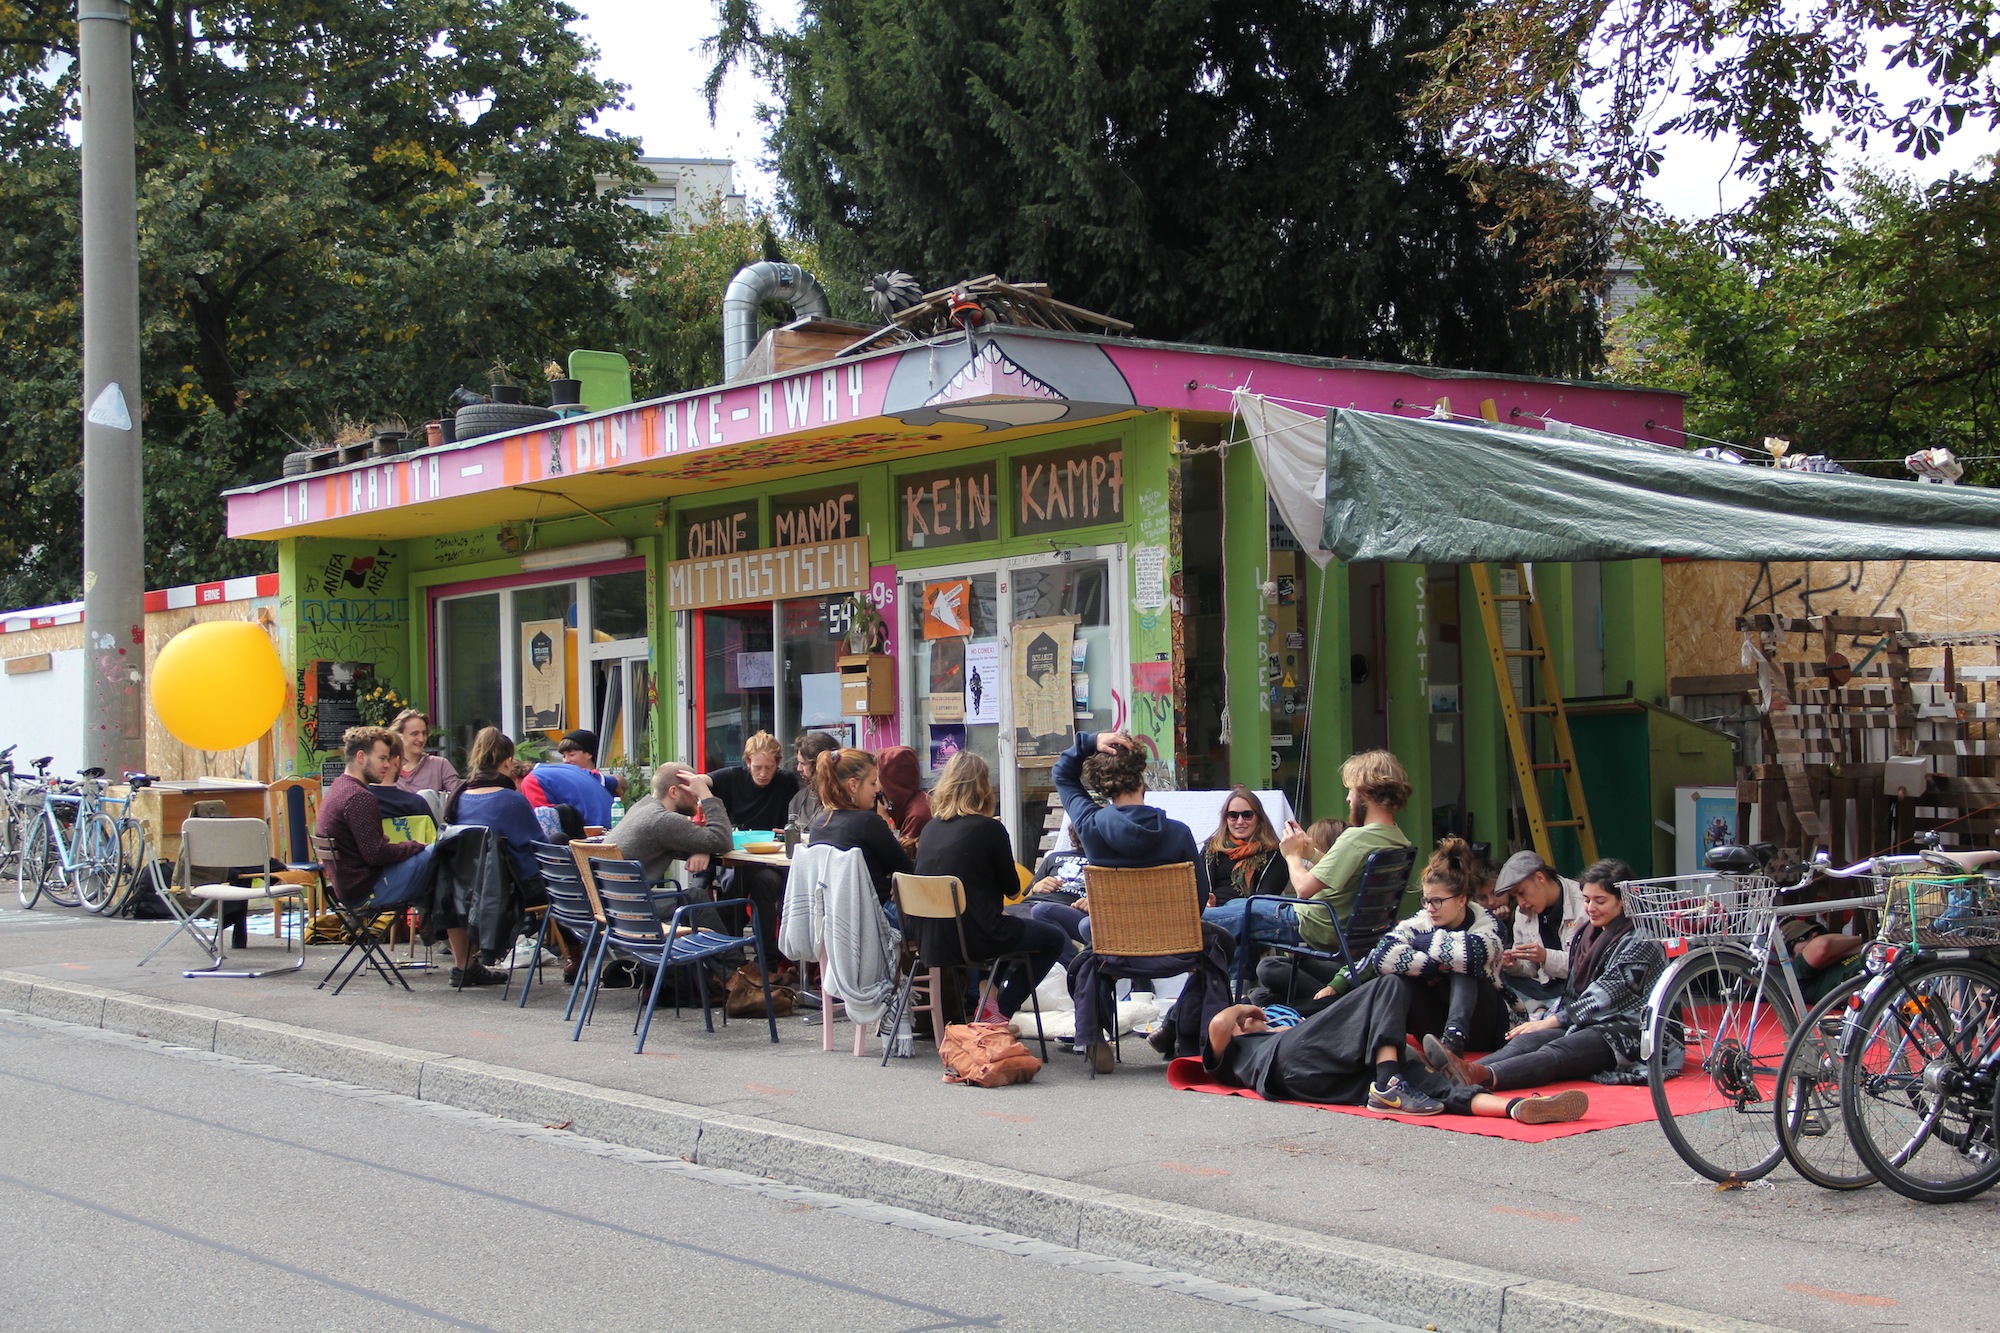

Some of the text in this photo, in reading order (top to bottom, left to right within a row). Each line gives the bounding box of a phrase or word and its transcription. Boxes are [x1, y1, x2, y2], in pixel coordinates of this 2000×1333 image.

[284, 482, 308, 525] LA
[775, 493, 855, 548] MAMPF
[906, 450, 1123, 542] KEIN KAMPF
[203, 588, 220, 602] ERNE
[323, 546, 398, 598] ANTIFA AREA!
[669, 541, 861, 606] MITTAGSTISCH!
[1255, 566, 1270, 712] LIEBER
[1415, 576, 1428, 697] STATT
